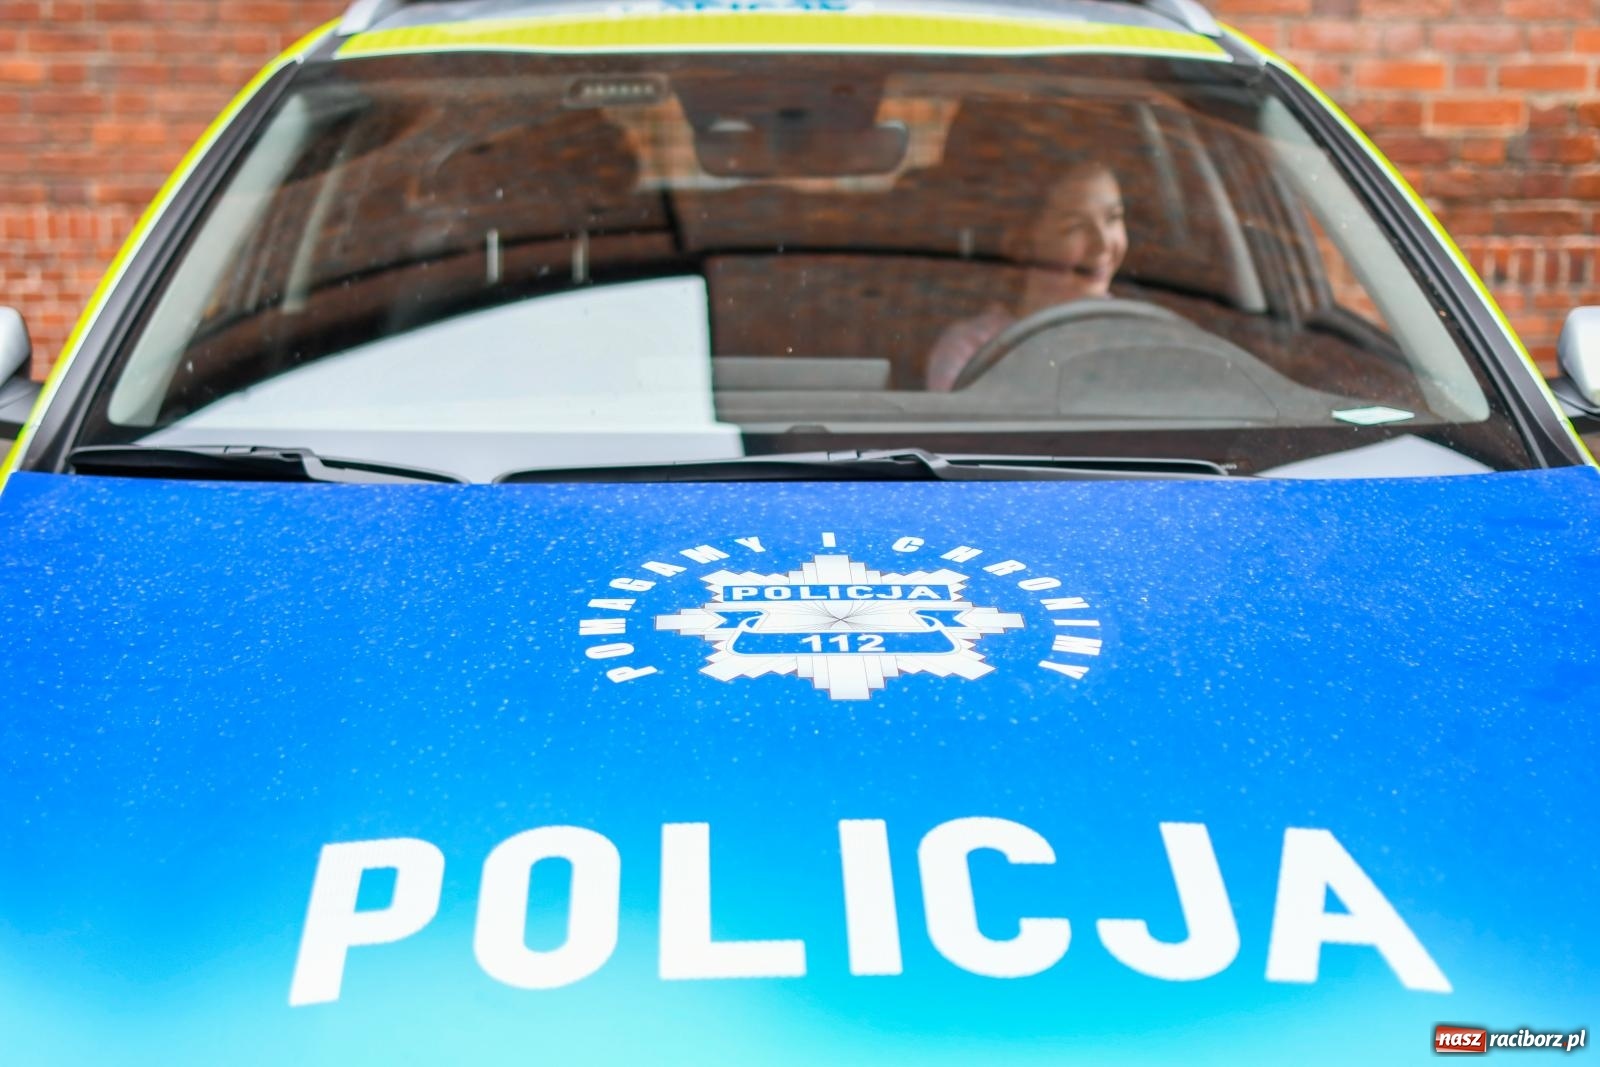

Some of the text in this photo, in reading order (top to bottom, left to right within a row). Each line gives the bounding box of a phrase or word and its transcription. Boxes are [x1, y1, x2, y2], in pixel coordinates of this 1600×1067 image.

[579, 532, 1103, 684] POMAGAMY I CHRONIMY
[731, 585, 942, 601] POLICJA
[801, 634, 886, 653] 112
[289, 816, 1453, 1007] POLICJA
